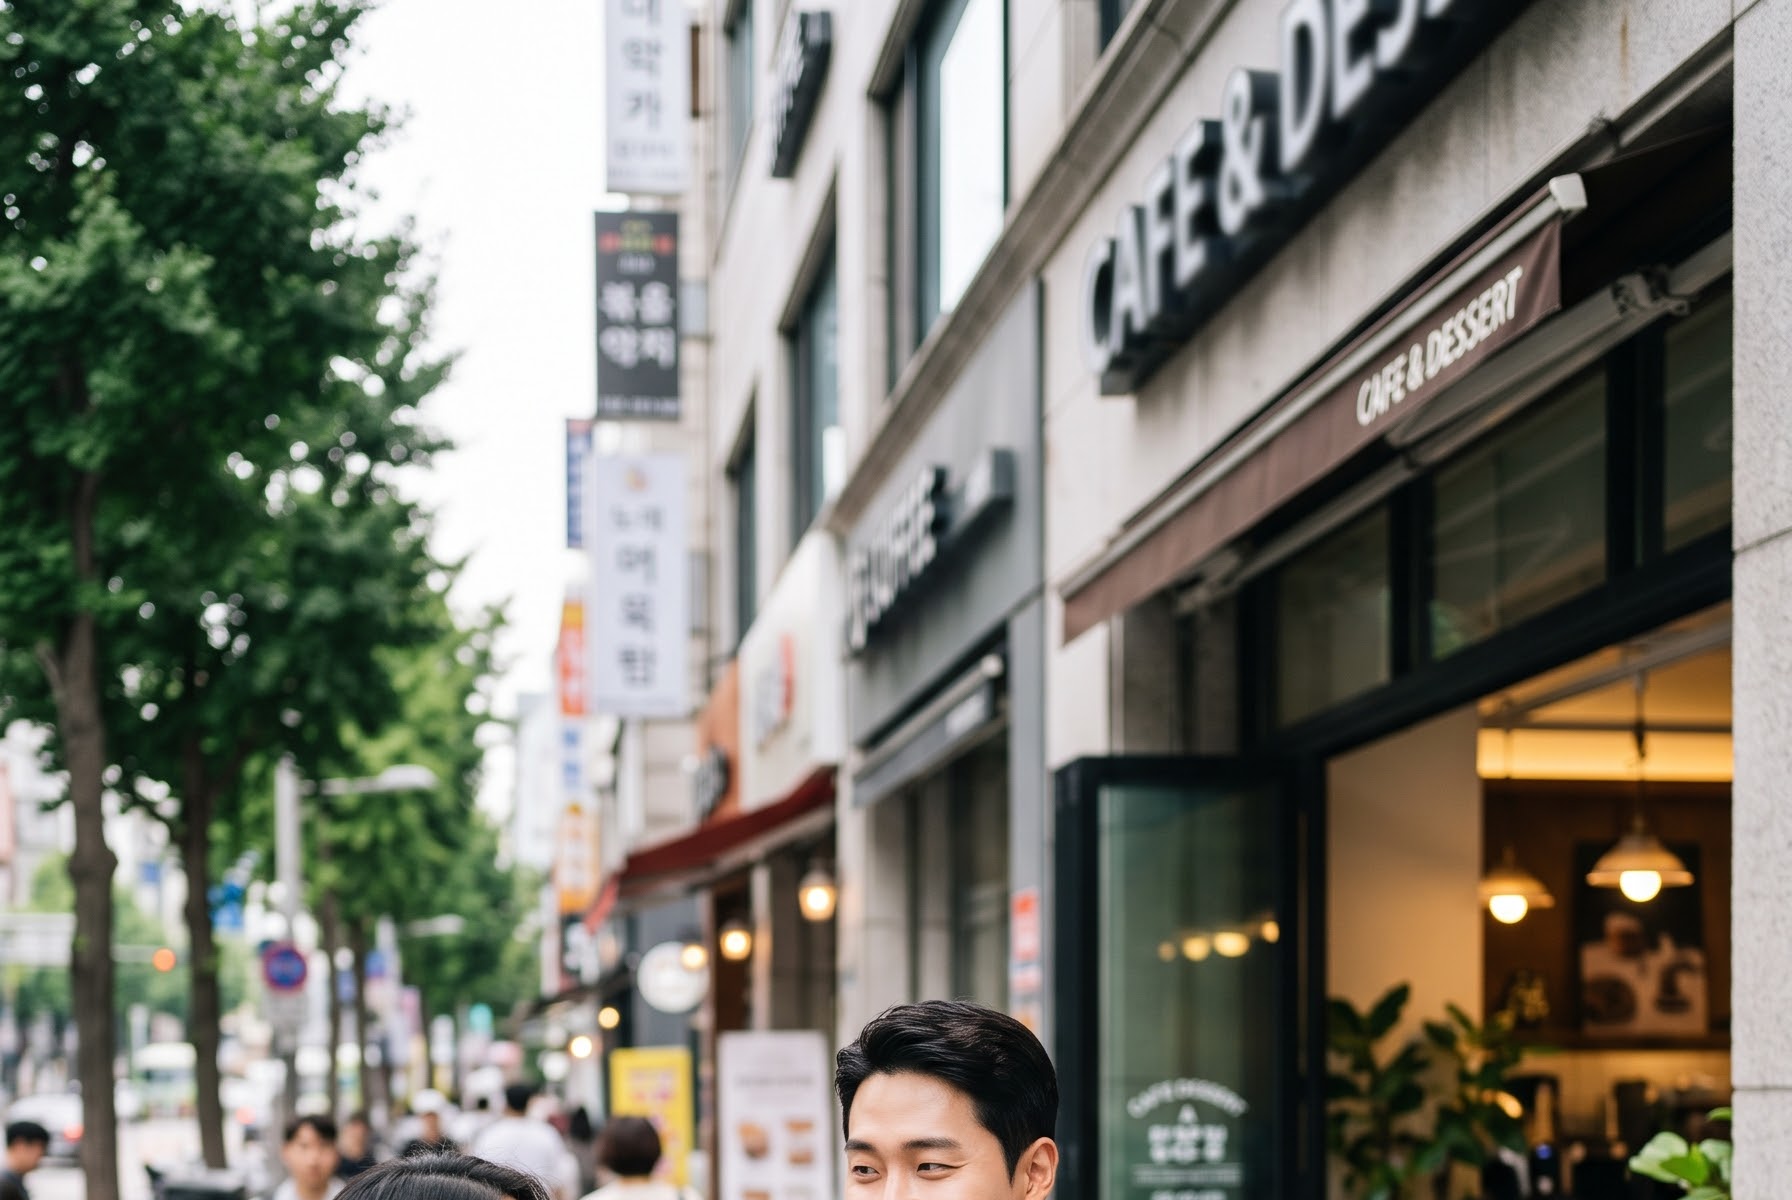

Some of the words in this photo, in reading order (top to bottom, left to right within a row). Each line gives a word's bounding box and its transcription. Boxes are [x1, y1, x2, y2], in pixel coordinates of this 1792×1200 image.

[1084, 121, 1206, 373] CAFE
[1218, 69, 1265, 235] &
[1280, 0, 1452, 173] DE
[1356, 352, 1407, 427] CAFE
[1407, 342, 1425, 392] &
[1425, 265, 1523, 380] DESSERT
